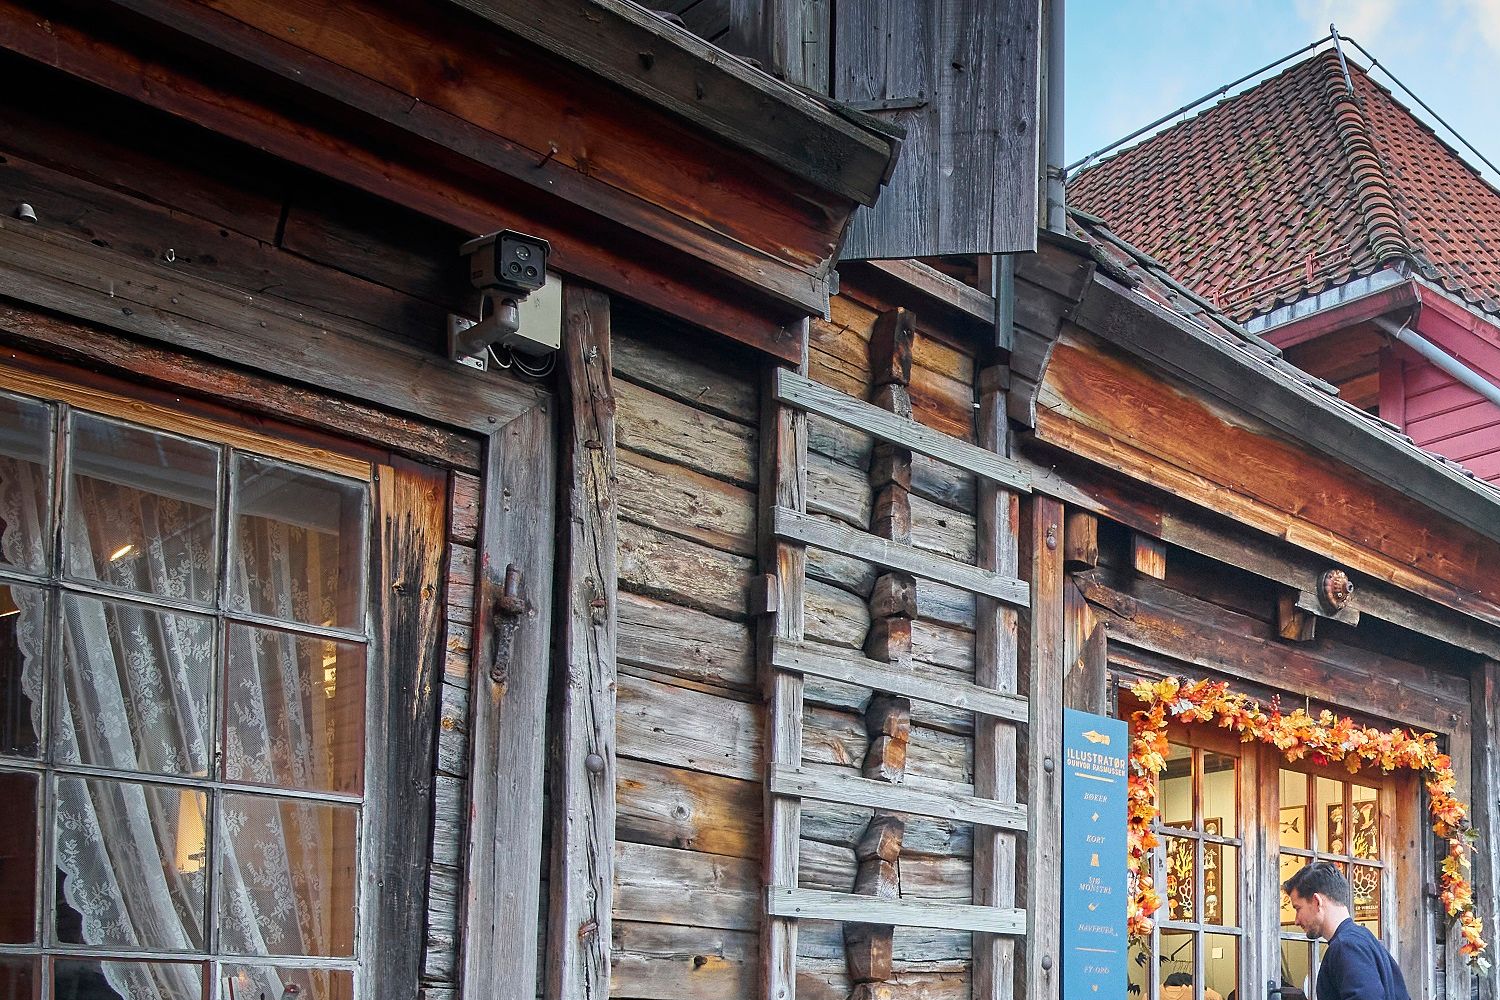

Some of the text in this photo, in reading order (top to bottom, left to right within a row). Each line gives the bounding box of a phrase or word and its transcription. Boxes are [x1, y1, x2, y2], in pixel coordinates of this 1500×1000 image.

[1067, 748, 1126, 769] ILLUSTRATØR
[1092, 764, 1126, 777] RASMUSSEN
[1084, 793, 1108, 802] BØKER
[1086, 835, 1105, 844] KORT
